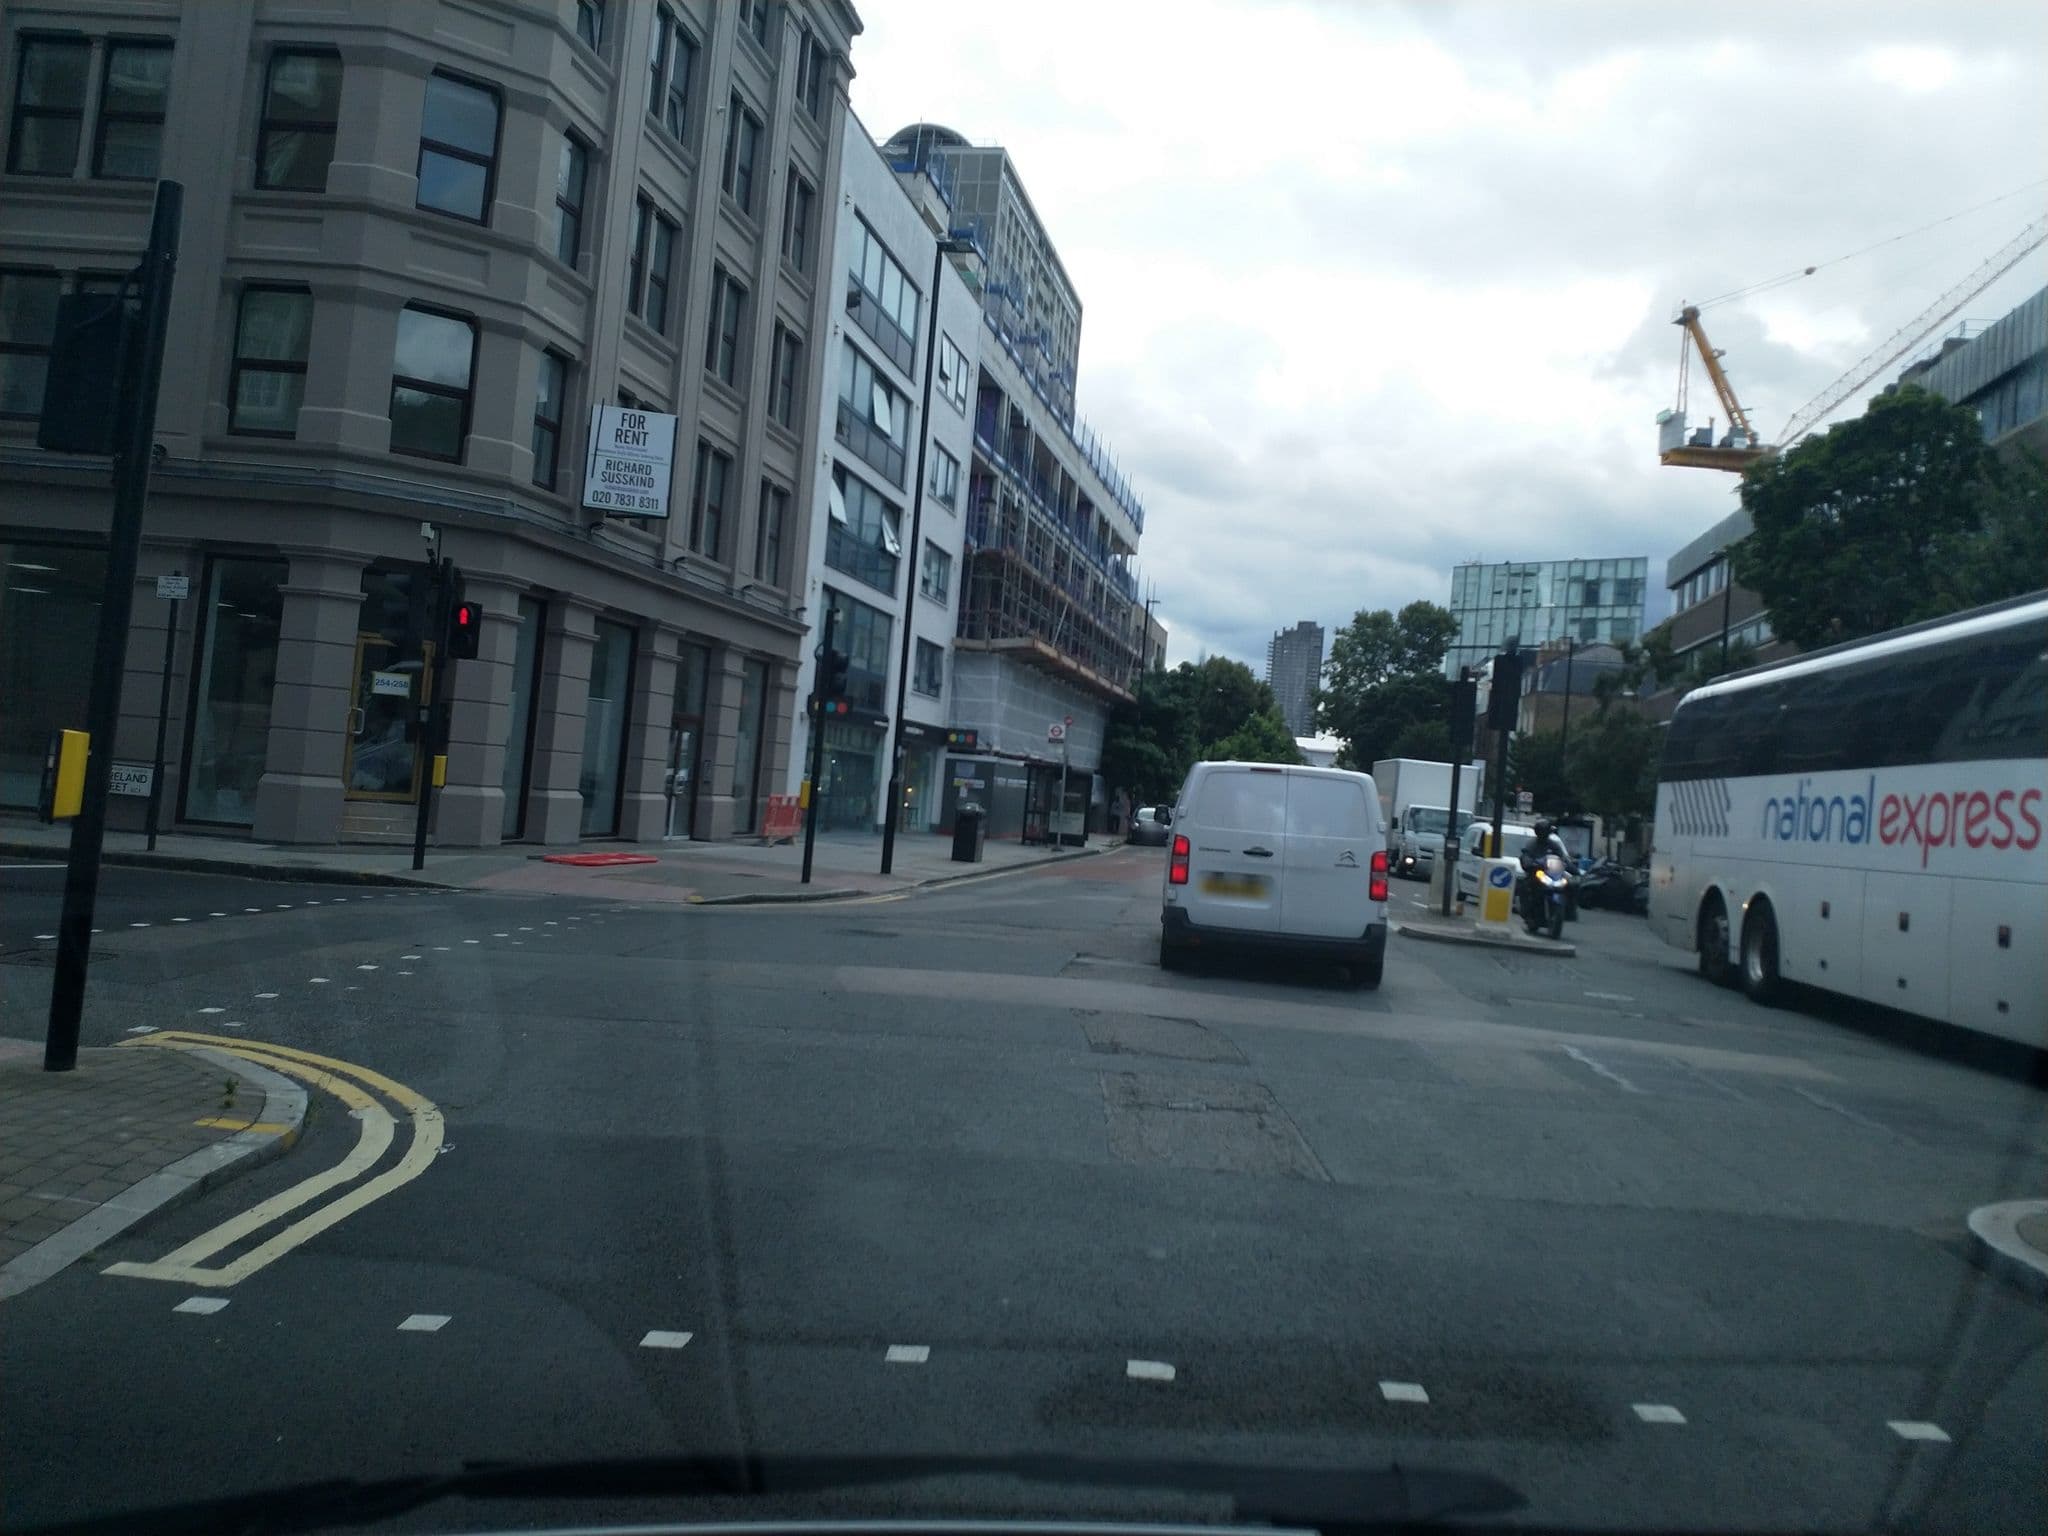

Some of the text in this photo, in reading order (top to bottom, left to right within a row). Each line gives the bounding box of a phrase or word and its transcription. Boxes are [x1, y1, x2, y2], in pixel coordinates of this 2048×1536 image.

[621, 413, 646, 430] FOR
[615, 428, 649, 447] RENT
[605, 459, 652, 476] RICHARD
[601, 471, 655, 488] SUSSKIND
[592, 490, 659, 510] 020 7831 8311
[111, 771, 148, 784] ELAND
[1763, 775, 2043, 869] national express
